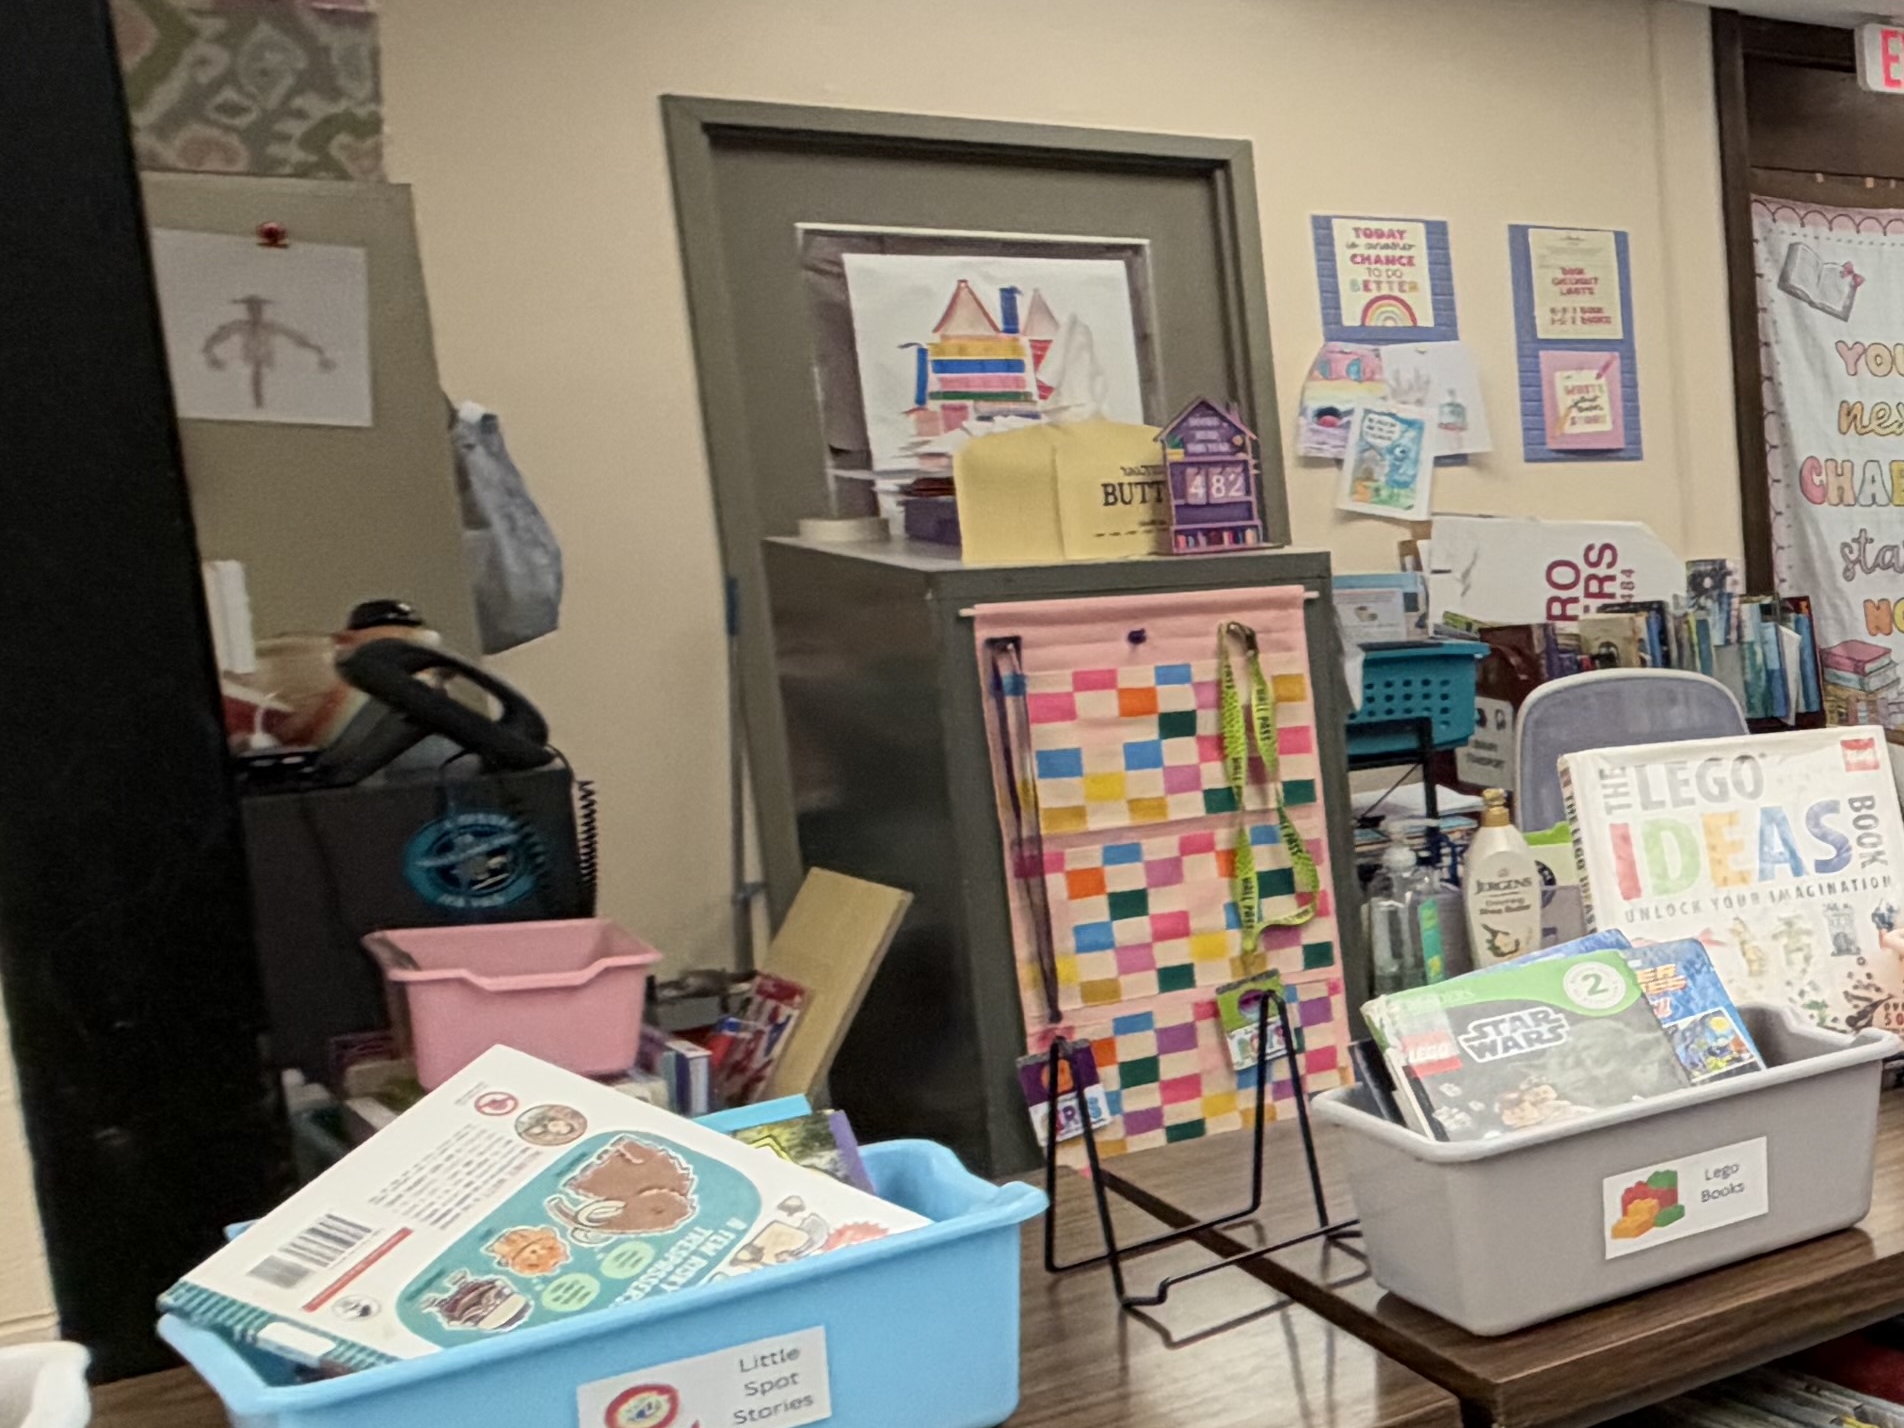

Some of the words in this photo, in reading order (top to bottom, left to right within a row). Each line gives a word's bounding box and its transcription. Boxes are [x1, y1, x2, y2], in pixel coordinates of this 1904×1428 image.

[1351, 227, 1407, 240] TODAY
[1350, 253, 1416, 267] CHANCE
[1366, 267, 1382, 278] TO
[1386, 268, 1403, 279] DO
[1349, 278, 1419, 293] BETTER
[1188, 473, 1245, 499] 482
[1598, 765, 1633, 816] THE
[1634, 754, 1766, 810] LEGO
[1563, 794, 1575, 822] THE
[1570, 827, 1586, 873] LEGO
[1848, 794, 1889, 870] BOOK
[1609, 799, 1855, 902] IDEAS
[1474, 877, 1532, 895] JERGENS
[1625, 899, 1702, 924] UNLOCK
[1711, 890, 1761, 912] YOUR
[1768, 875, 1893, 903] IMAGINATION
[1582, 972, 1610, 999] 2
[1464, 1008, 1566, 1037] STAR
[1404, 1042, 1450, 1065] LEGO
[1463, 1024, 1570, 1061] WARS
[1703, 1161, 1741, 1184] Lego
[1700, 1180, 1746, 1203] Books
[738, 1348, 800, 1373] Little
[743, 1372, 800, 1397] Spot
[732, 1394, 815, 1425] Stories
